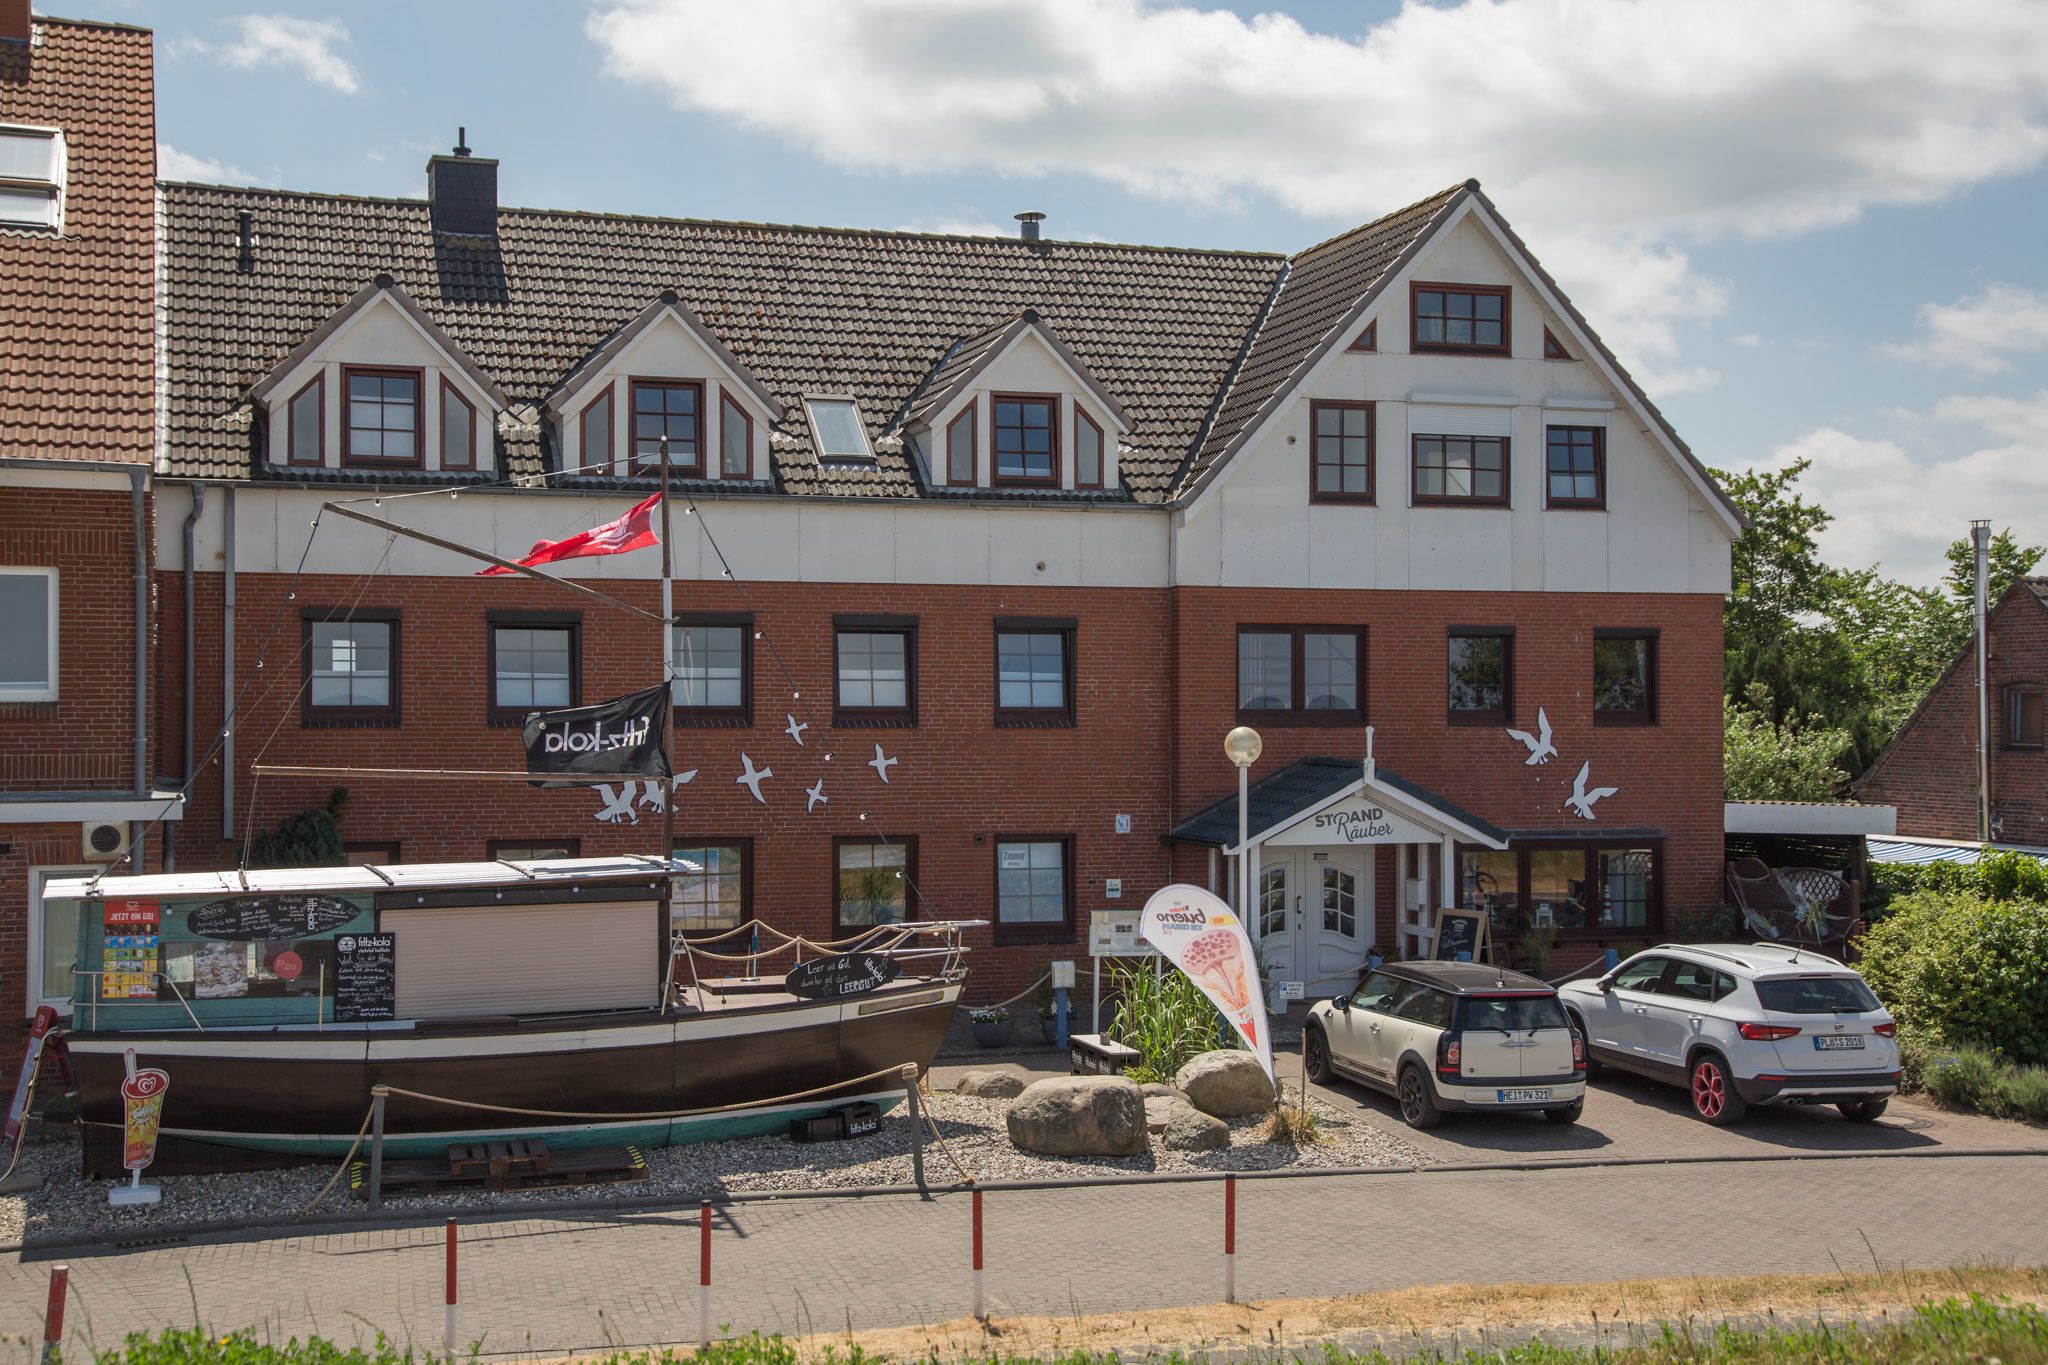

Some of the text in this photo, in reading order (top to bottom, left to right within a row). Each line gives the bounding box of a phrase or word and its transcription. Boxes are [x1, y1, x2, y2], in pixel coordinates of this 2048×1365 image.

[1315, 808, 1383, 830] STRAND
[1334, 812, 1394, 843] Räuber
[358, 936, 391, 947] fritz-kola
[839, 975, 876, 995] LEERGUT
[1534, 1090, 1548, 1100] 321
